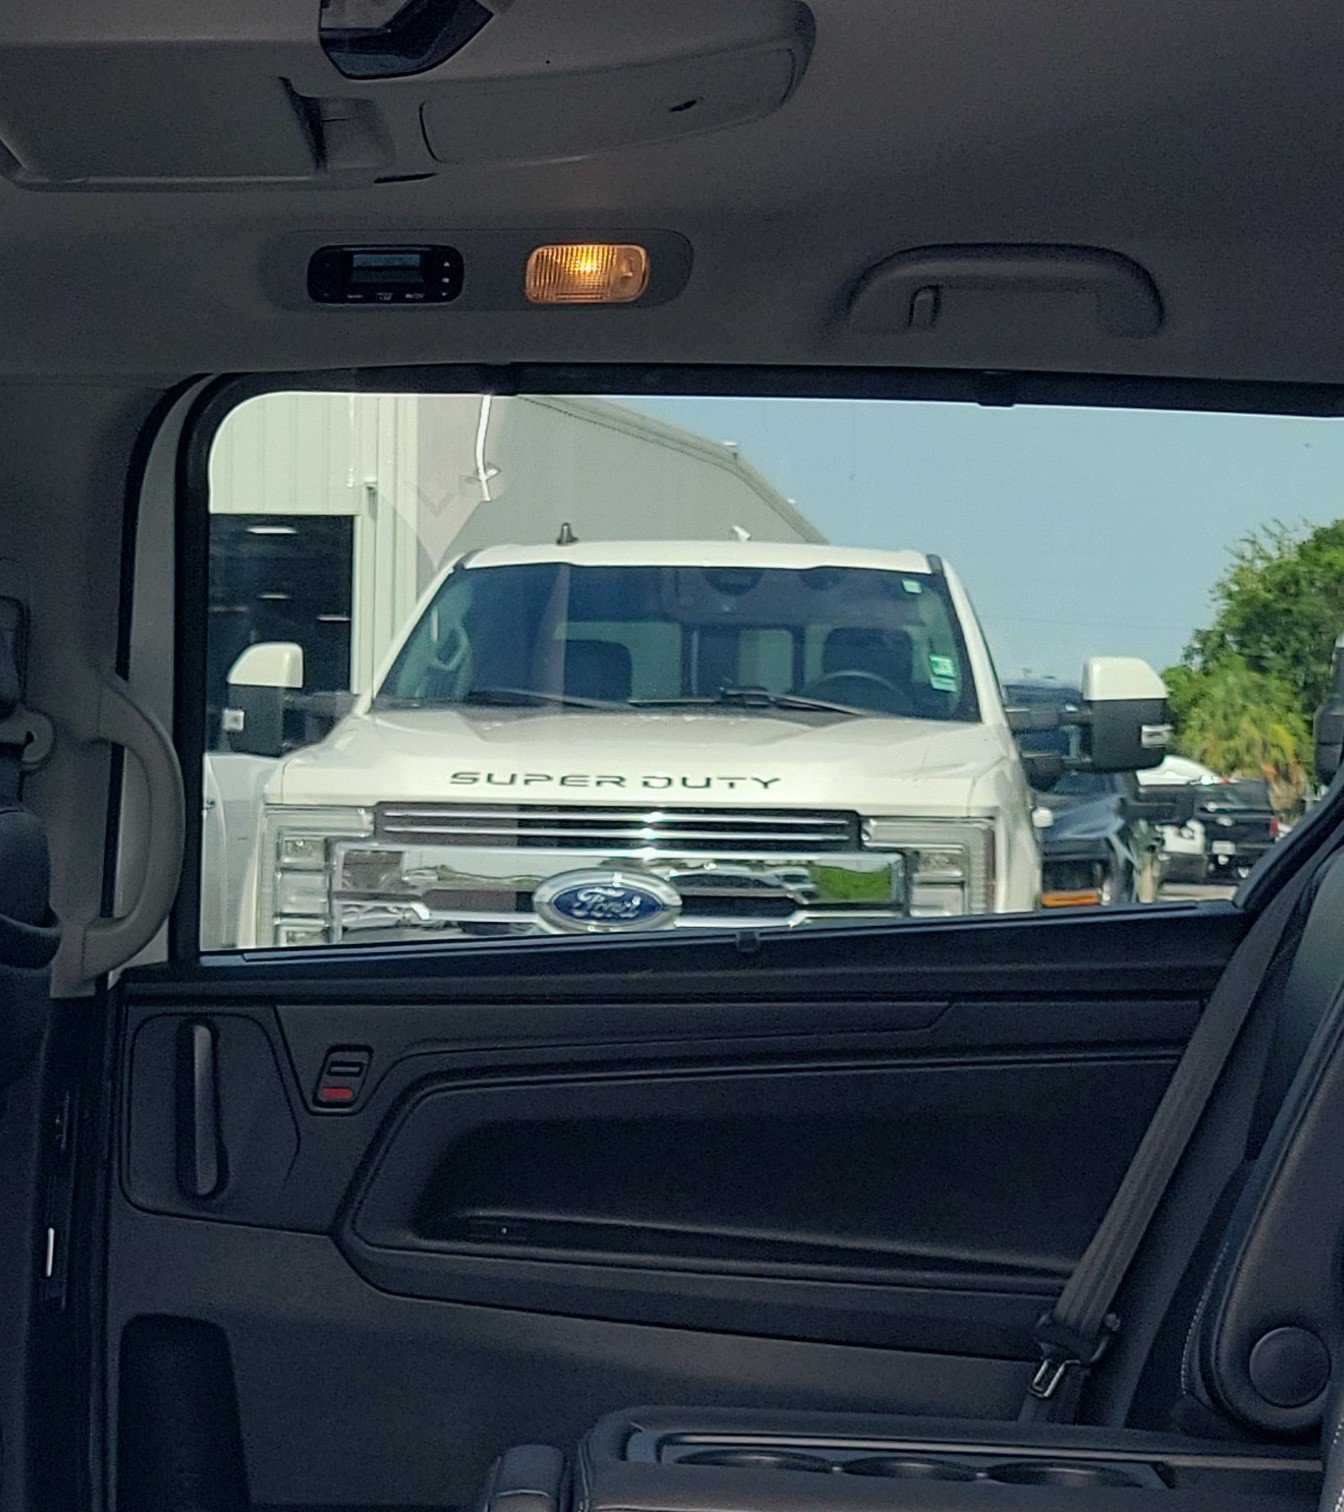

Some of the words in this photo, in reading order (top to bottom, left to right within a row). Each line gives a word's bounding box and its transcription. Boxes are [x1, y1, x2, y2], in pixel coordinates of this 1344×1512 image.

[450, 771, 626, 788] SUPER
[642, 775, 781, 789] DUTY
[573, 887, 642, 919] Ford
